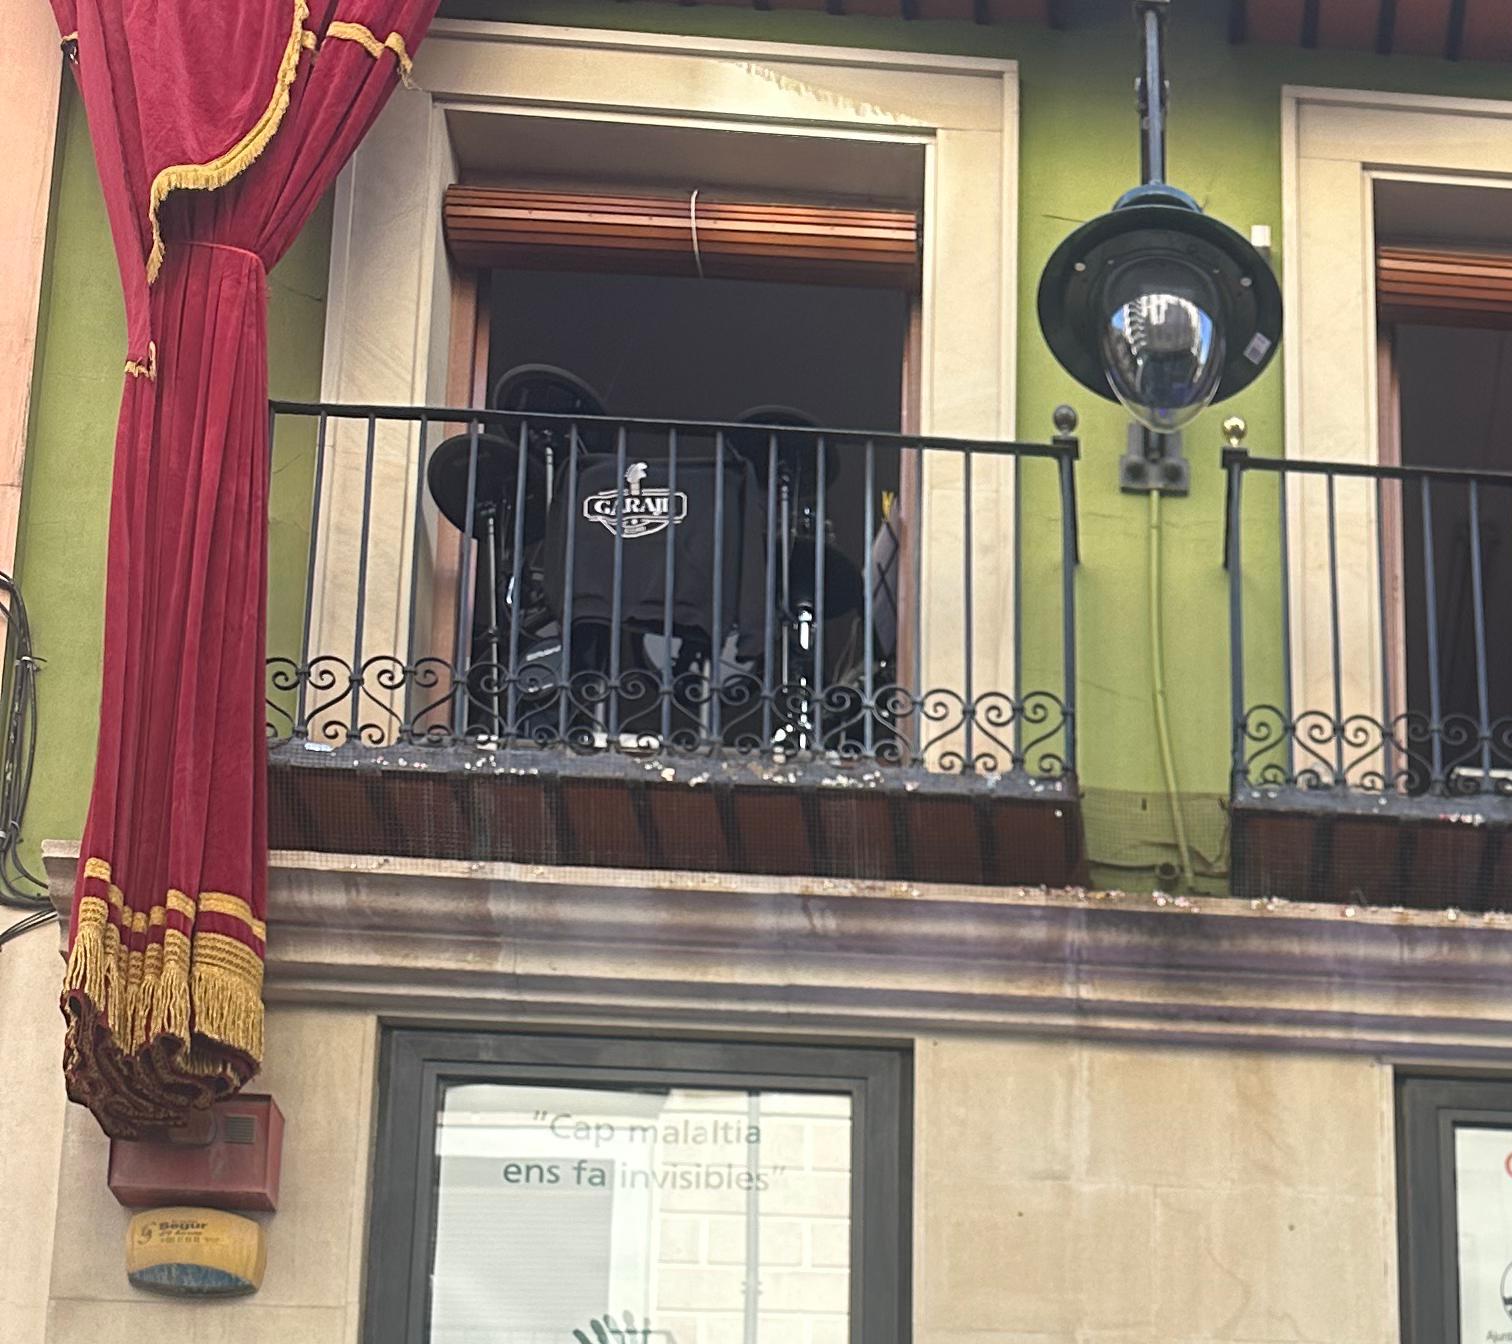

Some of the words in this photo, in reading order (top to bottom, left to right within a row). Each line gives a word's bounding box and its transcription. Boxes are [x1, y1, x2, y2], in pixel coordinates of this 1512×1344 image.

[594, 498, 669, 515] GRAJ
[628, 1119, 762, 1145] malaltia
[502, 1162, 561, 1185] ens
[571, 1159, 606, 1187] fa
